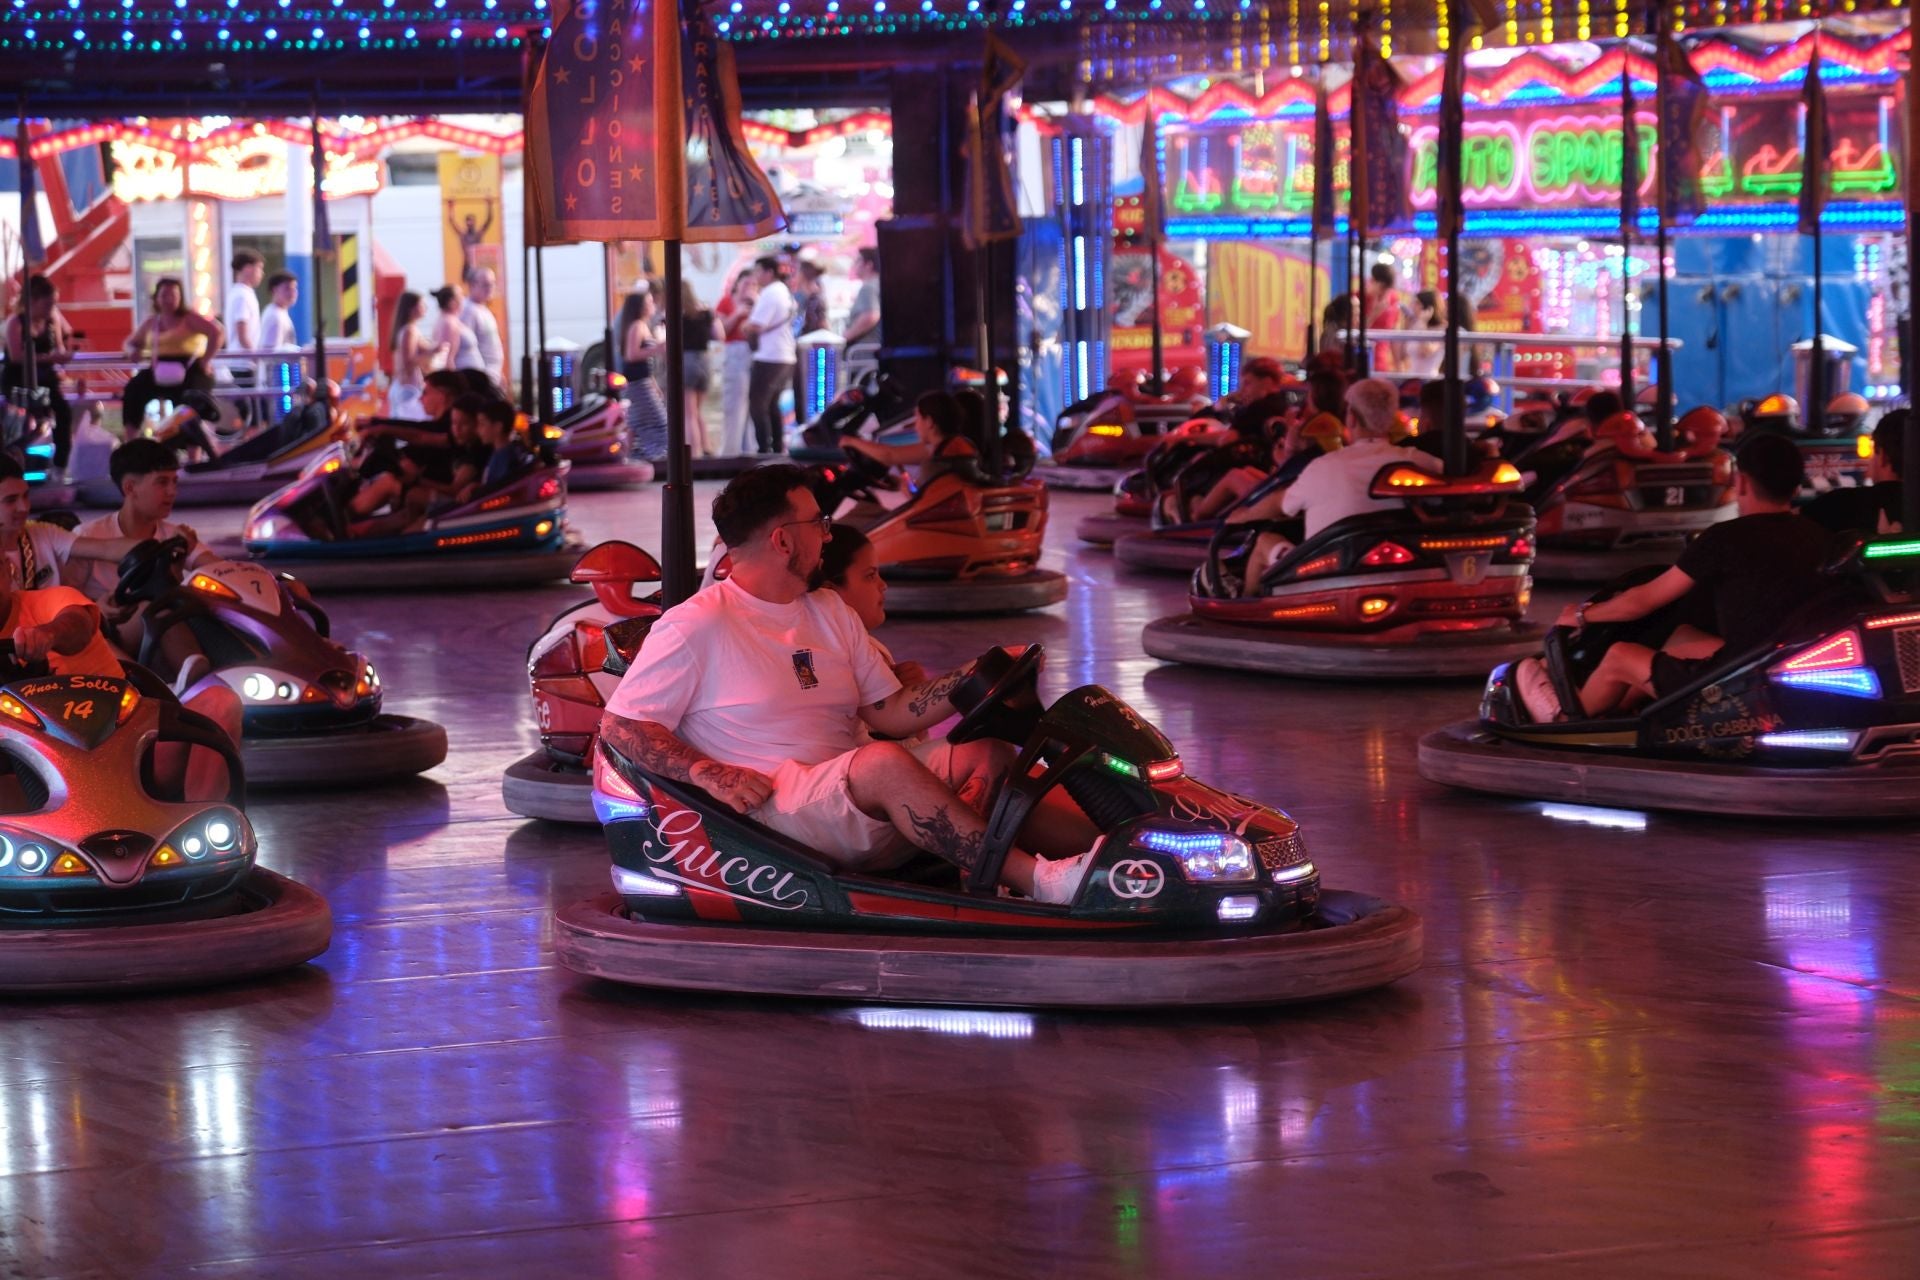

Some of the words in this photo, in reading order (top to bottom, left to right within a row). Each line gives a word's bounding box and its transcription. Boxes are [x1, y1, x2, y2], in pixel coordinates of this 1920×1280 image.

[1412, 132, 1514, 192] ATO
[250, 580, 262, 595] 7
[63, 700, 94, 719] 14
[642, 804, 808, 910] Gucci
